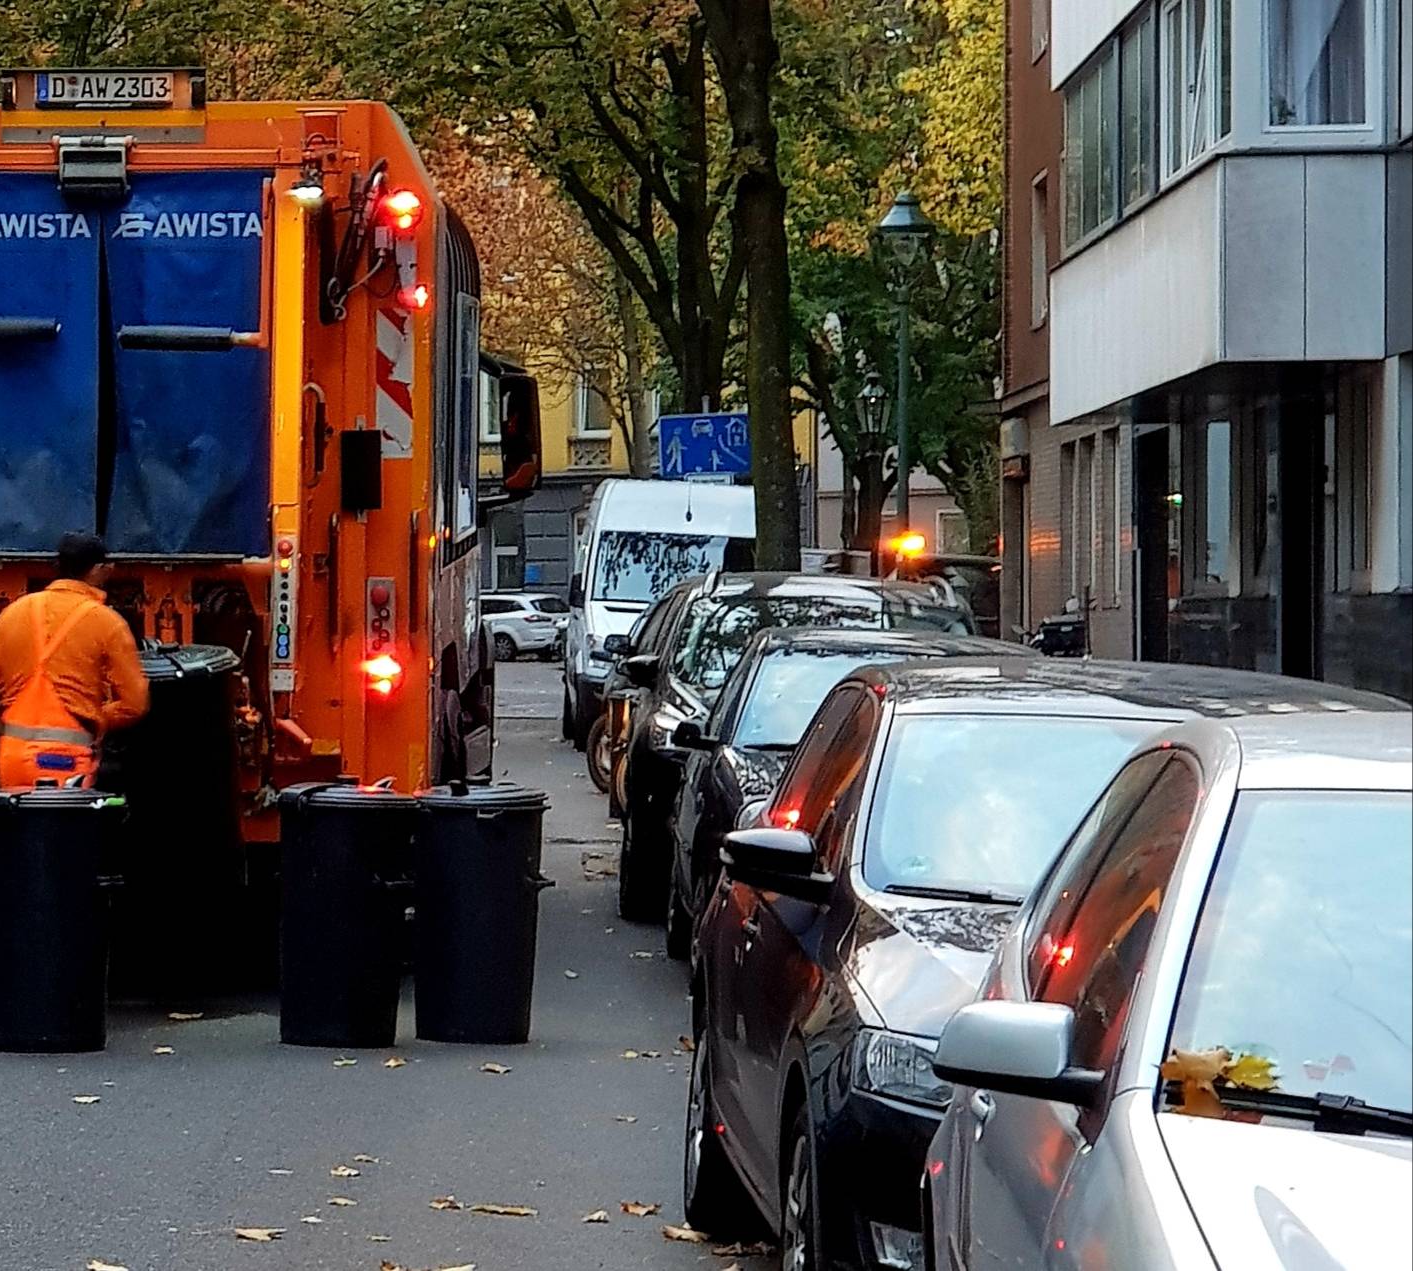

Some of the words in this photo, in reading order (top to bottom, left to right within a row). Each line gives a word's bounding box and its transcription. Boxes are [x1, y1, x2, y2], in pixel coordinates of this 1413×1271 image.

[52, 77, 65, 98] D
[81, 77, 109, 98] AW
[114, 77, 168, 98] 2303
[153, 212, 263, 238] AWISTA
